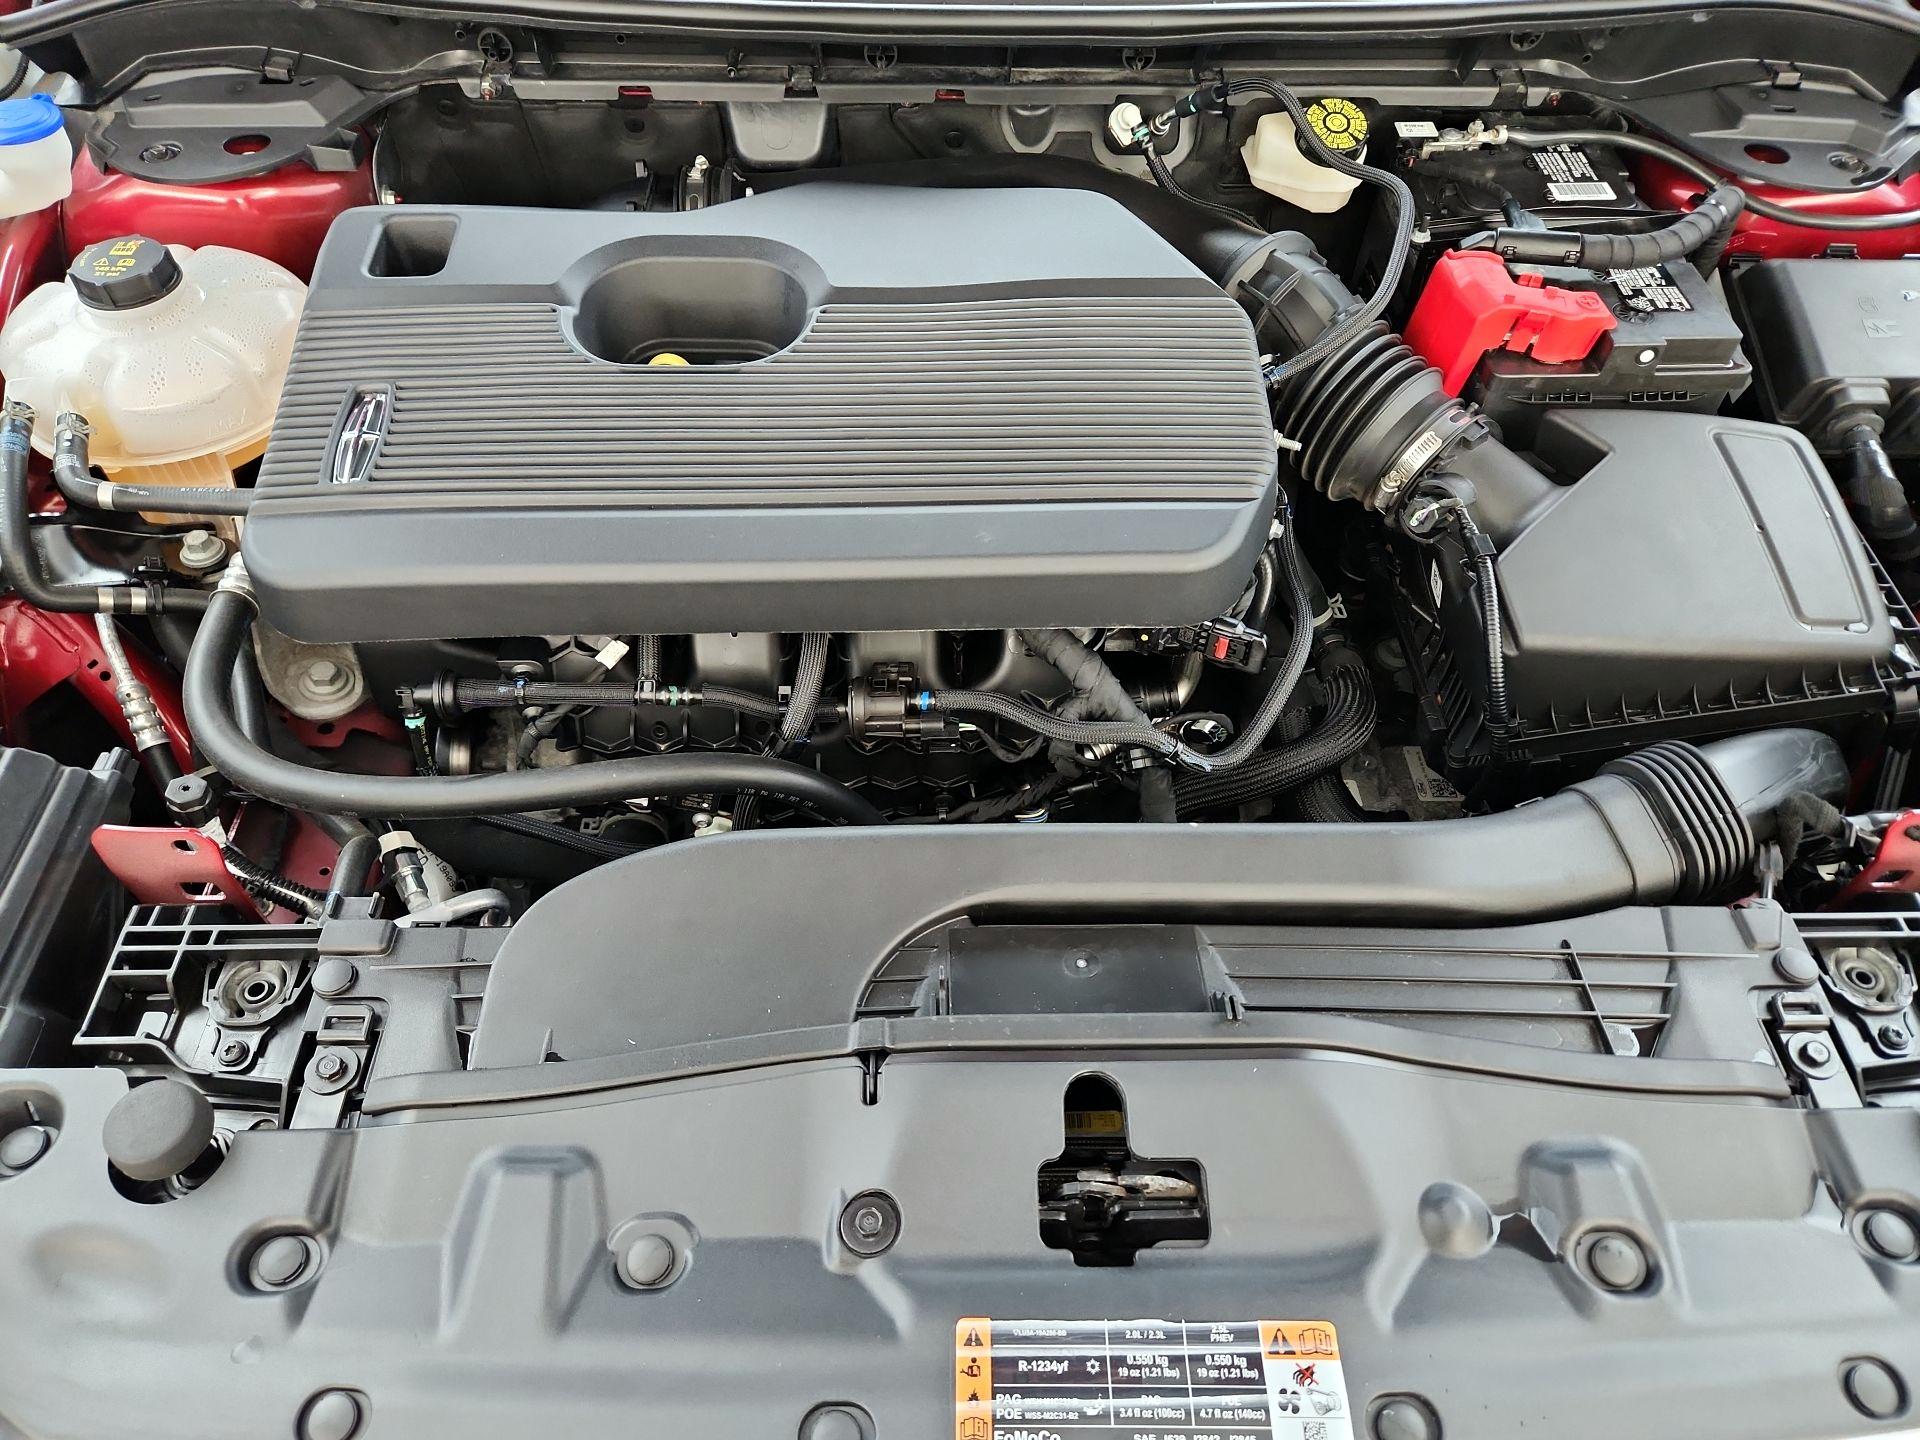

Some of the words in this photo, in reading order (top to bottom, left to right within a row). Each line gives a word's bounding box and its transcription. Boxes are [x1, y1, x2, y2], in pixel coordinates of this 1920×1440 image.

[1125, 1330, 1143, 1339] 2.0L
[1148, 1330, 1167, 1339] 2.3L
[1210, 1334, 1234, 1343] PHEV
[1126, 1354, 1154, 1366] 0.550
[1155, 1354, 1169, 1368] kg
[1205, 1354, 1232, 1366] 0.550
[1233, 1355, 1248, 1369] kg
[1018, 1360, 1070, 1375] R-1234yf
[1117, 1367, 1128, 1377] 19
[1129, 1369, 1141, 1377] oz
[1141, 1367, 1162, 1379] (1.21
[1162, 1367, 1180, 1380] lbs)
[1197, 1368, 1208, 1378] 19
[1208, 1370, 1220, 1378] oz
[1220, 1368, 1241, 1380] (1.21
[1241, 1368, 1259, 1380] lbs)
[995, 1393, 1022, 1405] PAG
[995, 1408, 1023, 1420] POE
[1120, 1407, 1133, 1418] 3.4
[1141, 1410, 1154, 1418] oz
[1200, 1408, 1213, 1418] 4.7
[1222, 1411, 1234, 1419] oz
